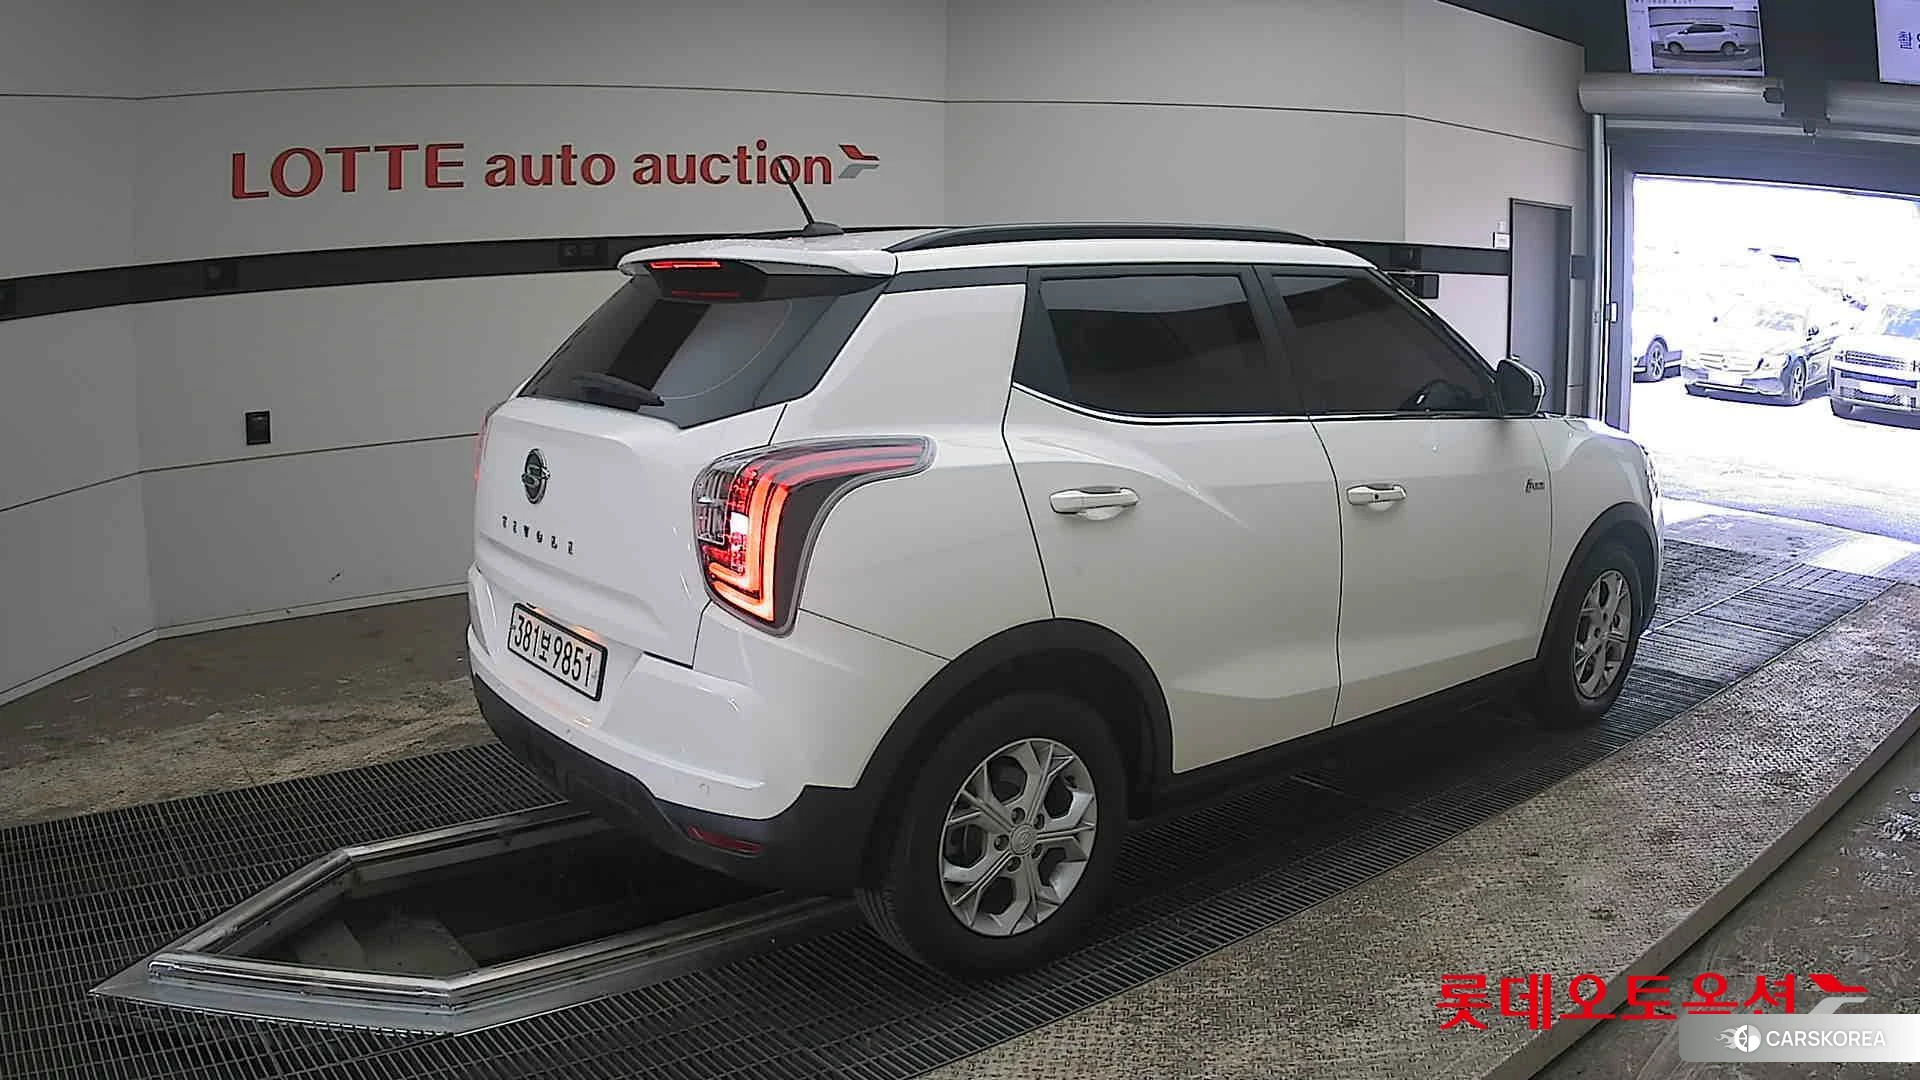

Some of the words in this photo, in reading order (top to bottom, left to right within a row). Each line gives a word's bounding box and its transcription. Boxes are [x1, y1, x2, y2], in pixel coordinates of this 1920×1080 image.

[231, 143, 465, 199] LOTTE
[484, 145, 616, 187] auto
[632, 139, 832, 185] auction
